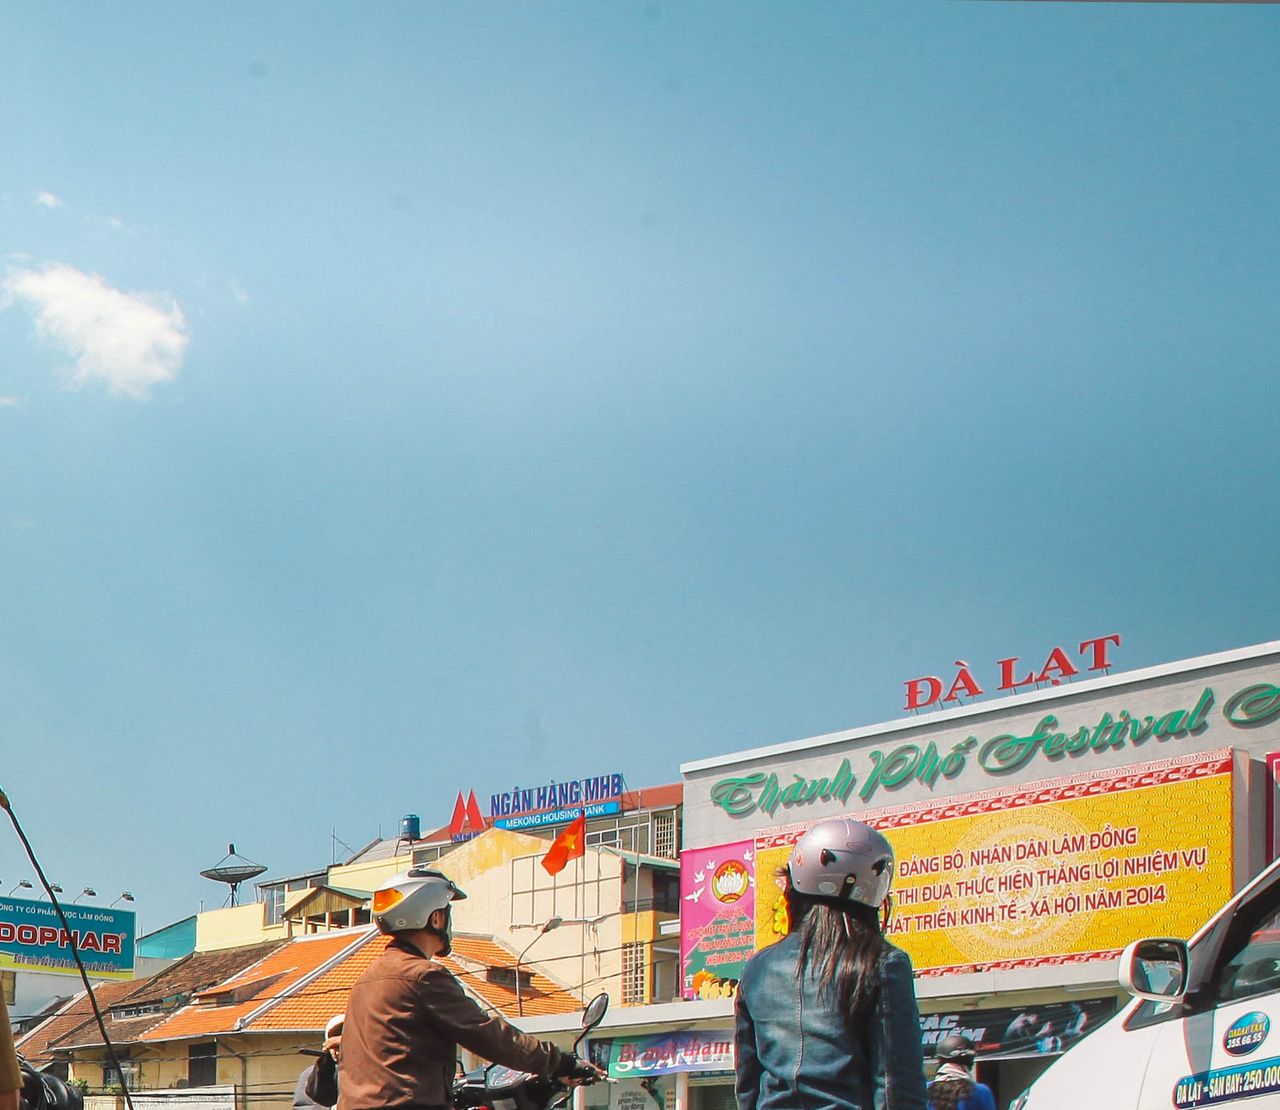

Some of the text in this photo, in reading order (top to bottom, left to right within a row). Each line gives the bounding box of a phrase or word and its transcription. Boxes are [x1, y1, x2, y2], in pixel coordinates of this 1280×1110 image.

[903, 634, 1120, 712] ĐÀ LẠT
[710, 757, 857, 819] Thành
[859, 735, 979, 803] Phố
[979, 686, 1217, 773] Festival
[490, 773, 622, 817] NGÂN HÀNG MHB
[505, 813, 541, 829] MEKONG
[542, 808, 580, 824] HOUSING
[898, 854, 940, 877] ĐẢNG
[969, 841, 1013, 868] NHÂN
[1015, 838, 1049, 860] DÂN
[1051, 832, 1086, 856] LÂM
[1088, 823, 1138, 850] ĐỒNG
[896, 887, 920, 906] THI
[922, 882, 954, 903] ĐUA
[956, 875, 995, 901] THỰC
[997, 868, 1034, 896] HIỆN
[1037, 860, 1091, 888] THẮNG
[1094, 856, 1120, 881] LỢI
[1123, 849, 1179, 878] NHIỆM
[1181, 847, 1207, 871] VỤ
[16, 905, 24, 914] TY
[25, 904, 36, 915] CỔ
[37, 905, 57, 917] PHẦN
[78, 911, 94, 922] LÂM
[94, 912, 115, 923] ĐỒNG
[914, 906, 957, 931] TRIỂN
[960, 907, 996, 927] KINH
[998, 896, 1019, 920] TẾ
[1029, 892, 1052, 917] XÃ
[1053, 891, 1082, 919] HỘI
[1084, 886, 1122, 911] NĂM
[1126, 884, 1167, 907] 2014
